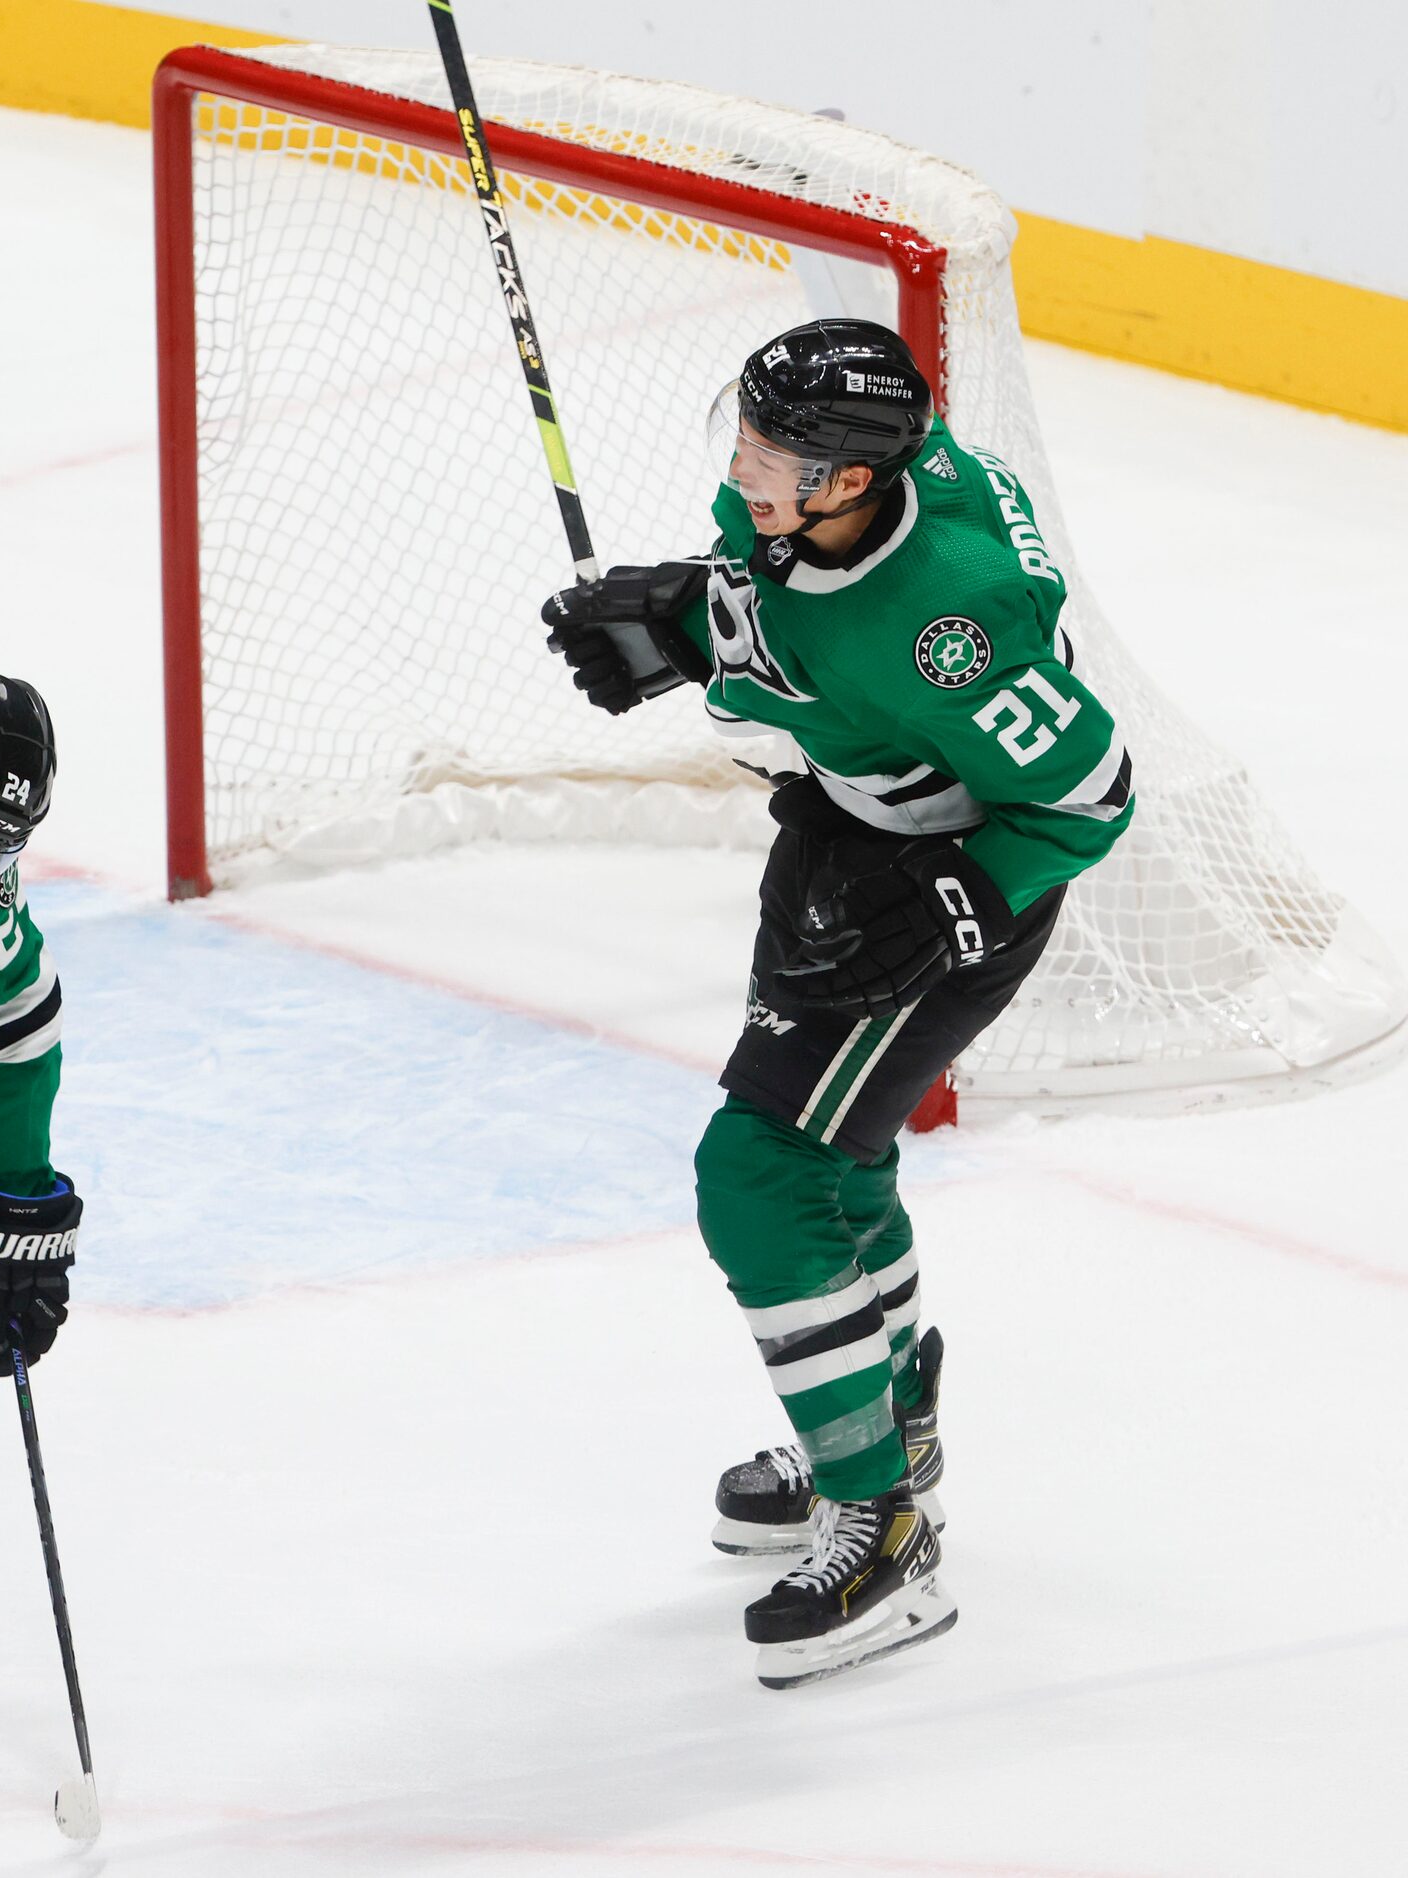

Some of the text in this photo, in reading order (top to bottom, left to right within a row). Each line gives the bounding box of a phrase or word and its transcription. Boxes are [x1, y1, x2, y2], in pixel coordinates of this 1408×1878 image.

[458, 107, 490, 192] SUPER
[480, 190, 527, 321] TACKS
[762, 344, 791, 371] 21
[744, 371, 763, 402] CCM
[866, 374, 905, 386] ENERGY
[866, 384, 913, 400] TRANSFER
[936, 447, 958, 480] adidas
[921, 621, 974, 664] DALLAS
[937, 648, 986, 685] STARS
[971, 666, 1082, 767] 21
[2, 771, 31, 806] 24
[935, 876, 984, 968] CCM
[12, 1347, 26, 1386] ALPHA
